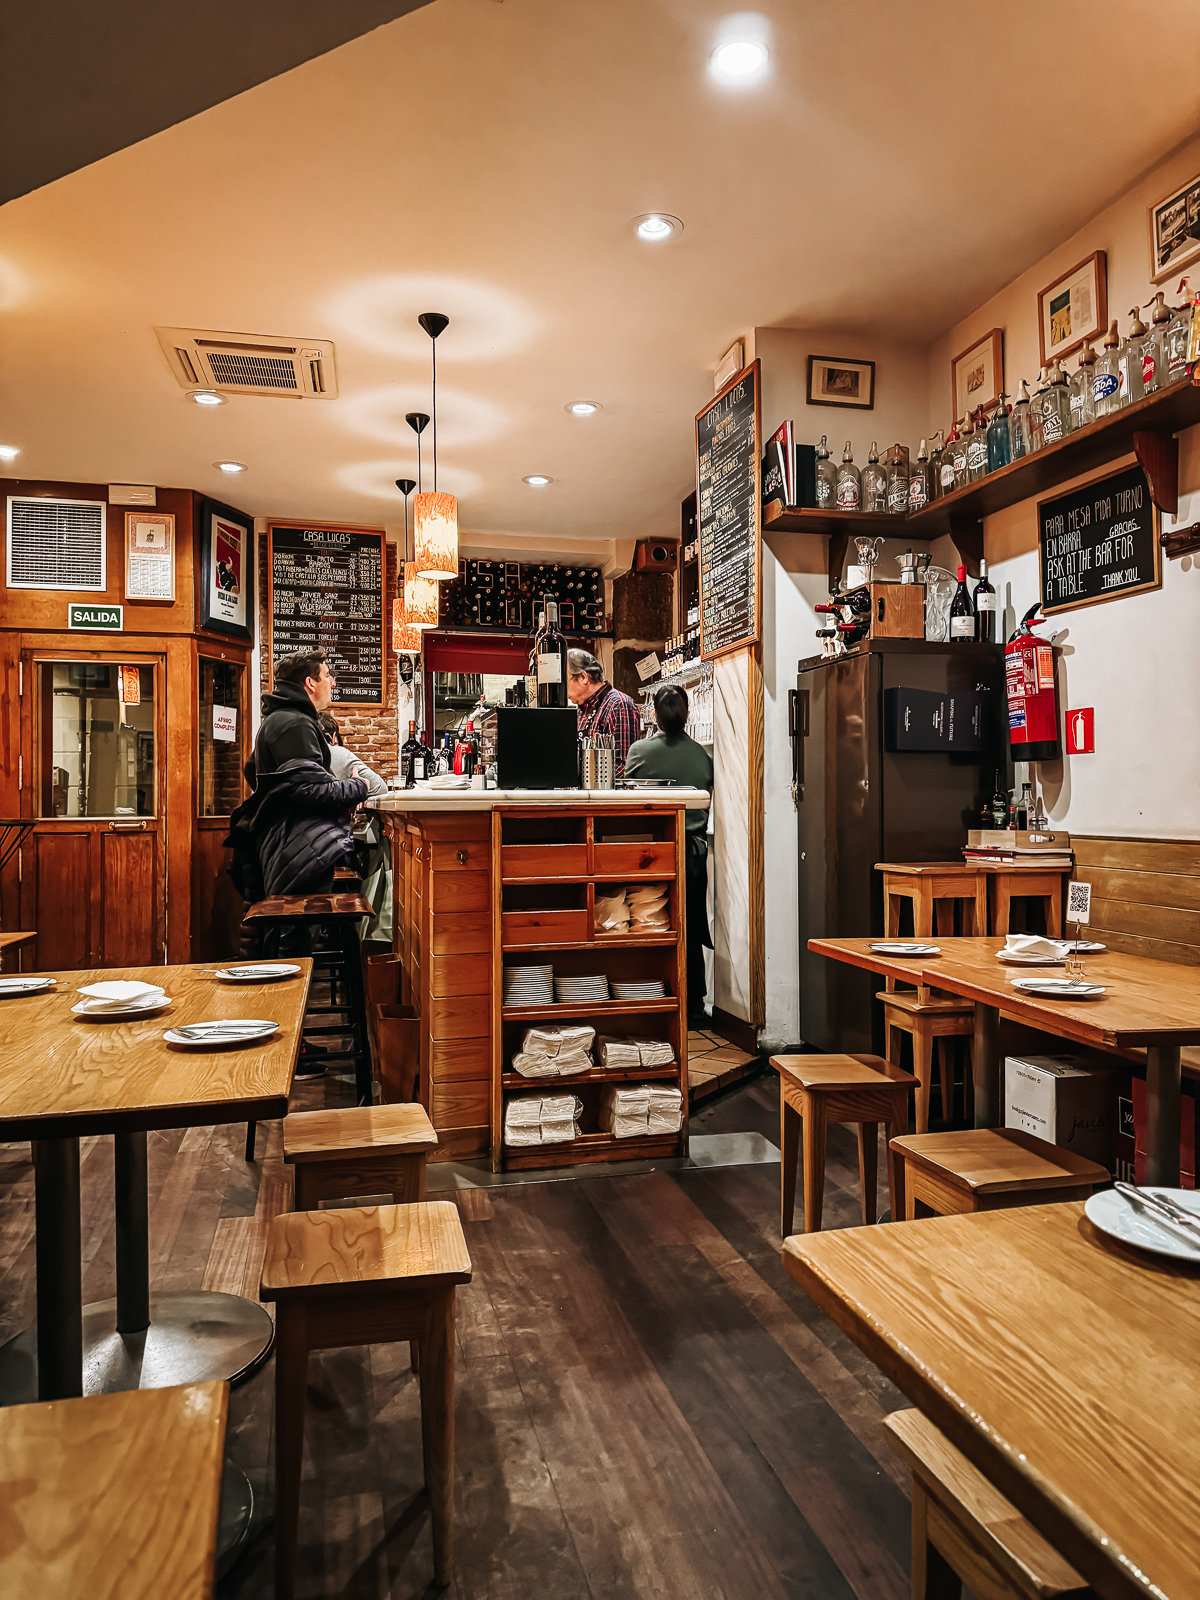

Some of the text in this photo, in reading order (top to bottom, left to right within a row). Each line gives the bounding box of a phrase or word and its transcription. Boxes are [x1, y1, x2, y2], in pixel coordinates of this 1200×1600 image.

[1045, 484, 1143, 539] PARA MESA PIDA TURNO
[304, 531, 350, 543] CASA LUCAS
[1109, 518, 1137, 537] GRACIAS
[1046, 537, 1057, 558] EN
[1047, 535, 1134, 580] ASK AT THE BAR FOR
[1046, 572, 1087, 600] A TABLE.
[1102, 566, 1138, 587] THANK YOU
[73, 611, 118, 623] SALIDA
[213, 722, 236, 732] COMPLETO
